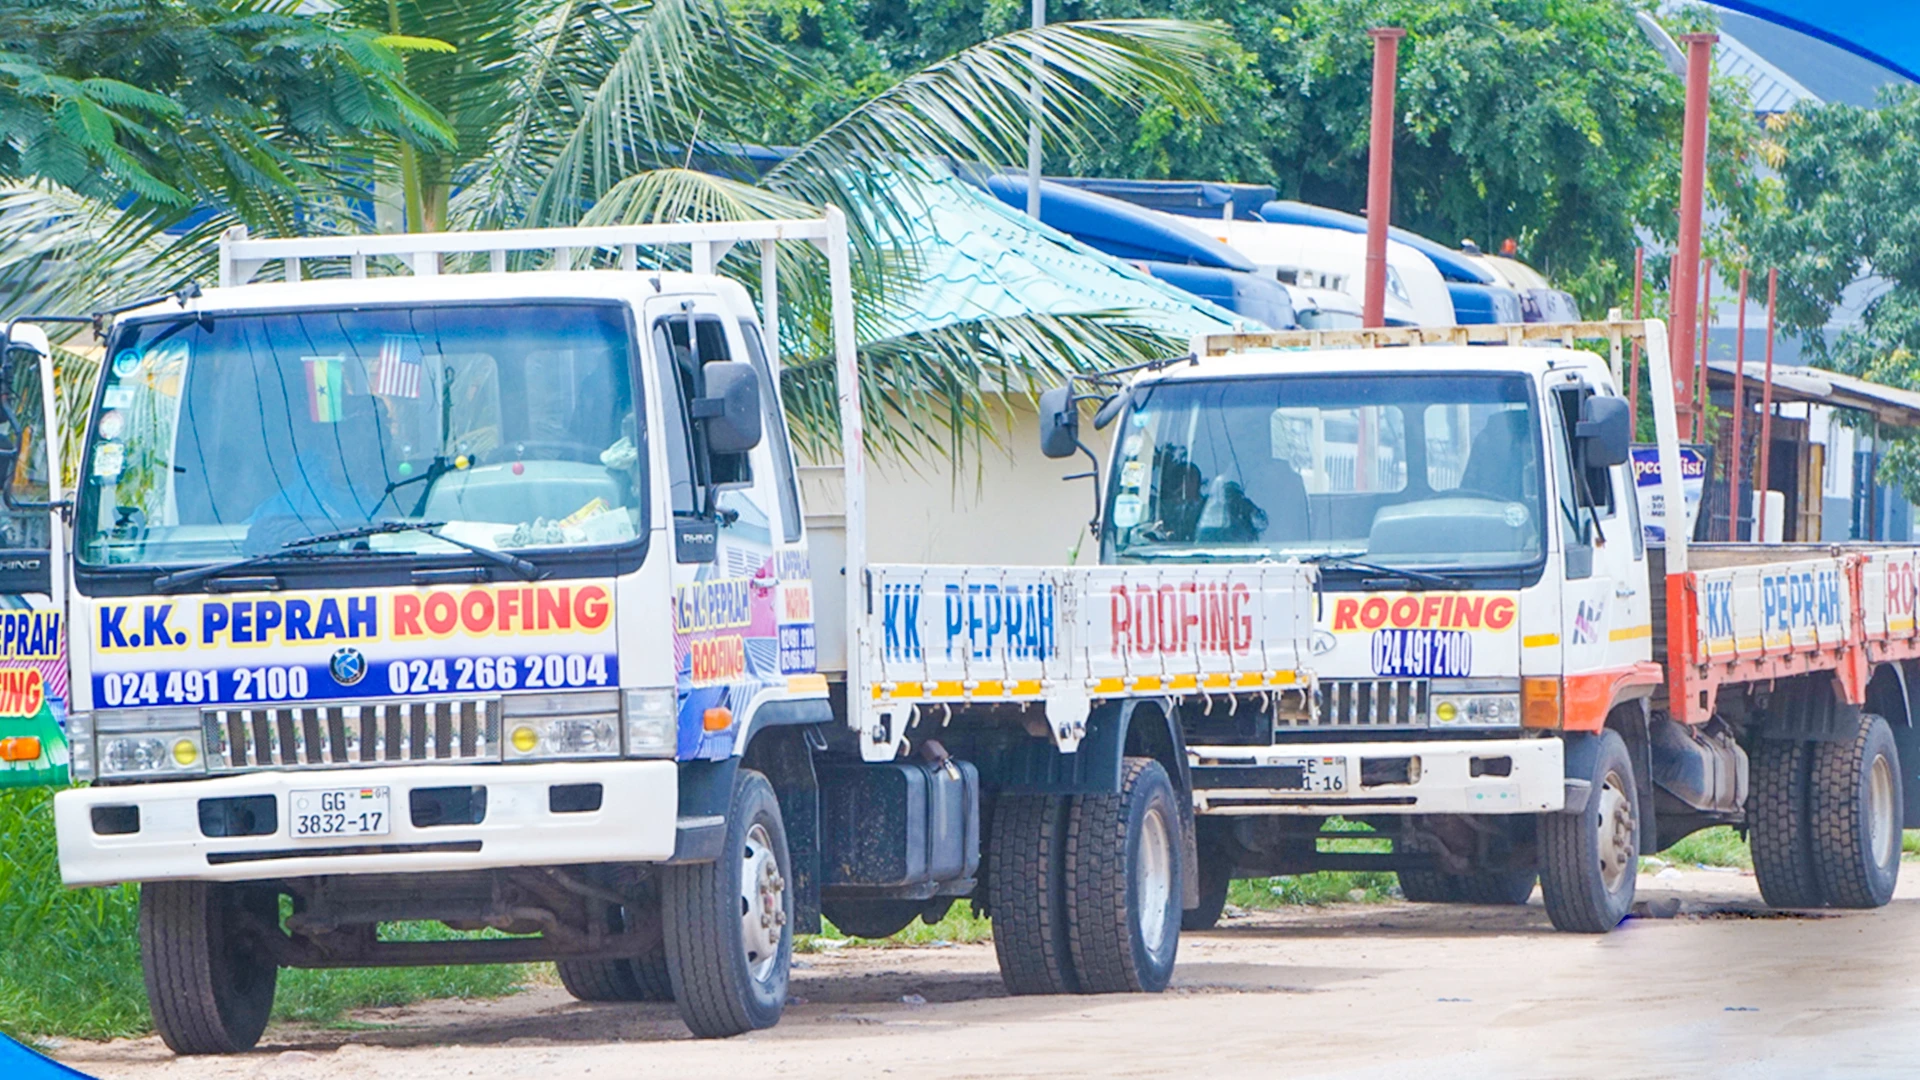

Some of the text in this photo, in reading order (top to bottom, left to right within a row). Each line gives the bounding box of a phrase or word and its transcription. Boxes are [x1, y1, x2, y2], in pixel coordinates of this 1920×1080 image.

[683, 533, 714, 545] RHINO
[707, 579, 750, 626] PEPRAH
[1707, 571, 1841, 638] KK PEPRAH
[1887, 561, 1920, 615] RO
[0, 612, 60, 656] PRAH
[100, 585, 609, 647] K.K. PEPRAH ROOFING
[884, 584, 921, 662] KK
[945, 583, 1054, 661] PEPRAH
[1110, 581, 1252, 658] ROOFING
[1333, 596, 1515, 631] ROOFING
[388, 653, 608, 694] 024 266 2004
[692, 638, 744, 682] ROOFING
[1373, 630, 1401, 675] 024
[1404, 630, 1432, 675] 491
[1434, 631, 1470, 676] 2100
[103, 665, 309, 705] 024 491 2100
[297, 812, 382, 835] 3832-17
[321, 791, 346, 812] GG
